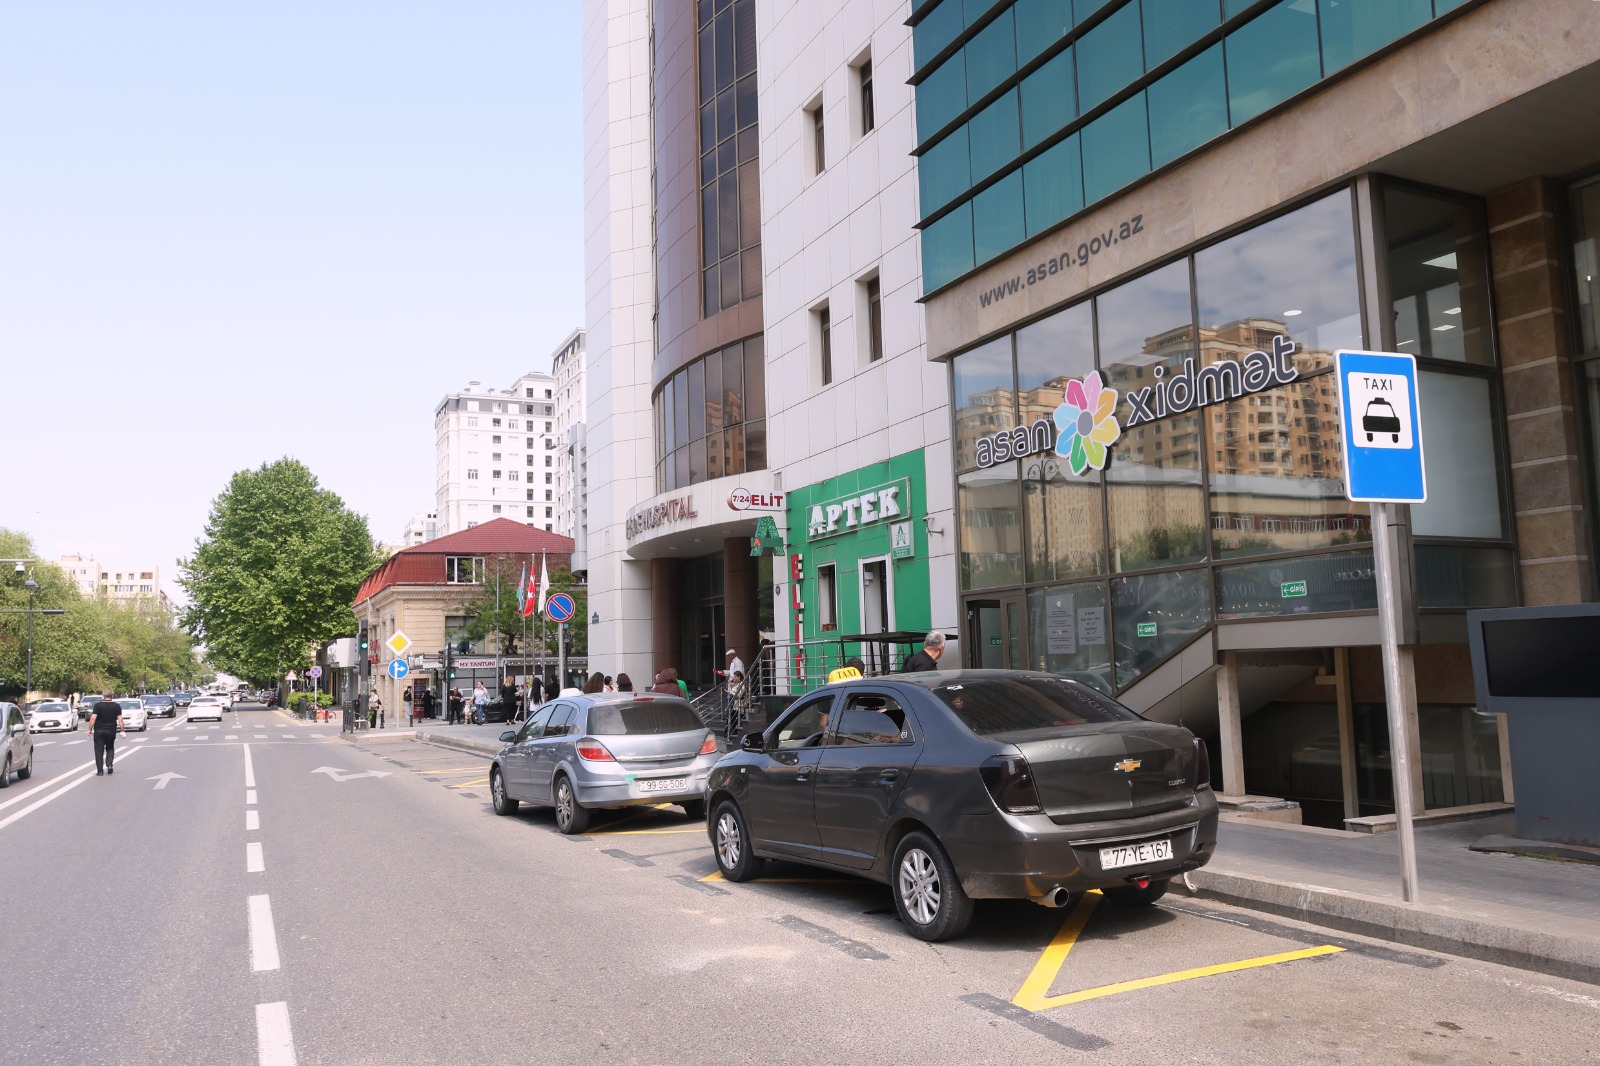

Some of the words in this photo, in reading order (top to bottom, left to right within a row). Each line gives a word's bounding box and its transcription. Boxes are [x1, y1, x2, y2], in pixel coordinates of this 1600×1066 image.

[979, 213, 1144, 309] www.asan.gov.az
[1363, 377, 1393, 391] TAXI
[975, 418, 1052, 469] asan
[1126, 335, 1299, 427] xidmət
[732, 495, 750, 503] 7/24
[751, 493, 783, 507] ELİT
[808, 486, 900, 536] APTEK
[836, 668, 857, 679] TAXI
